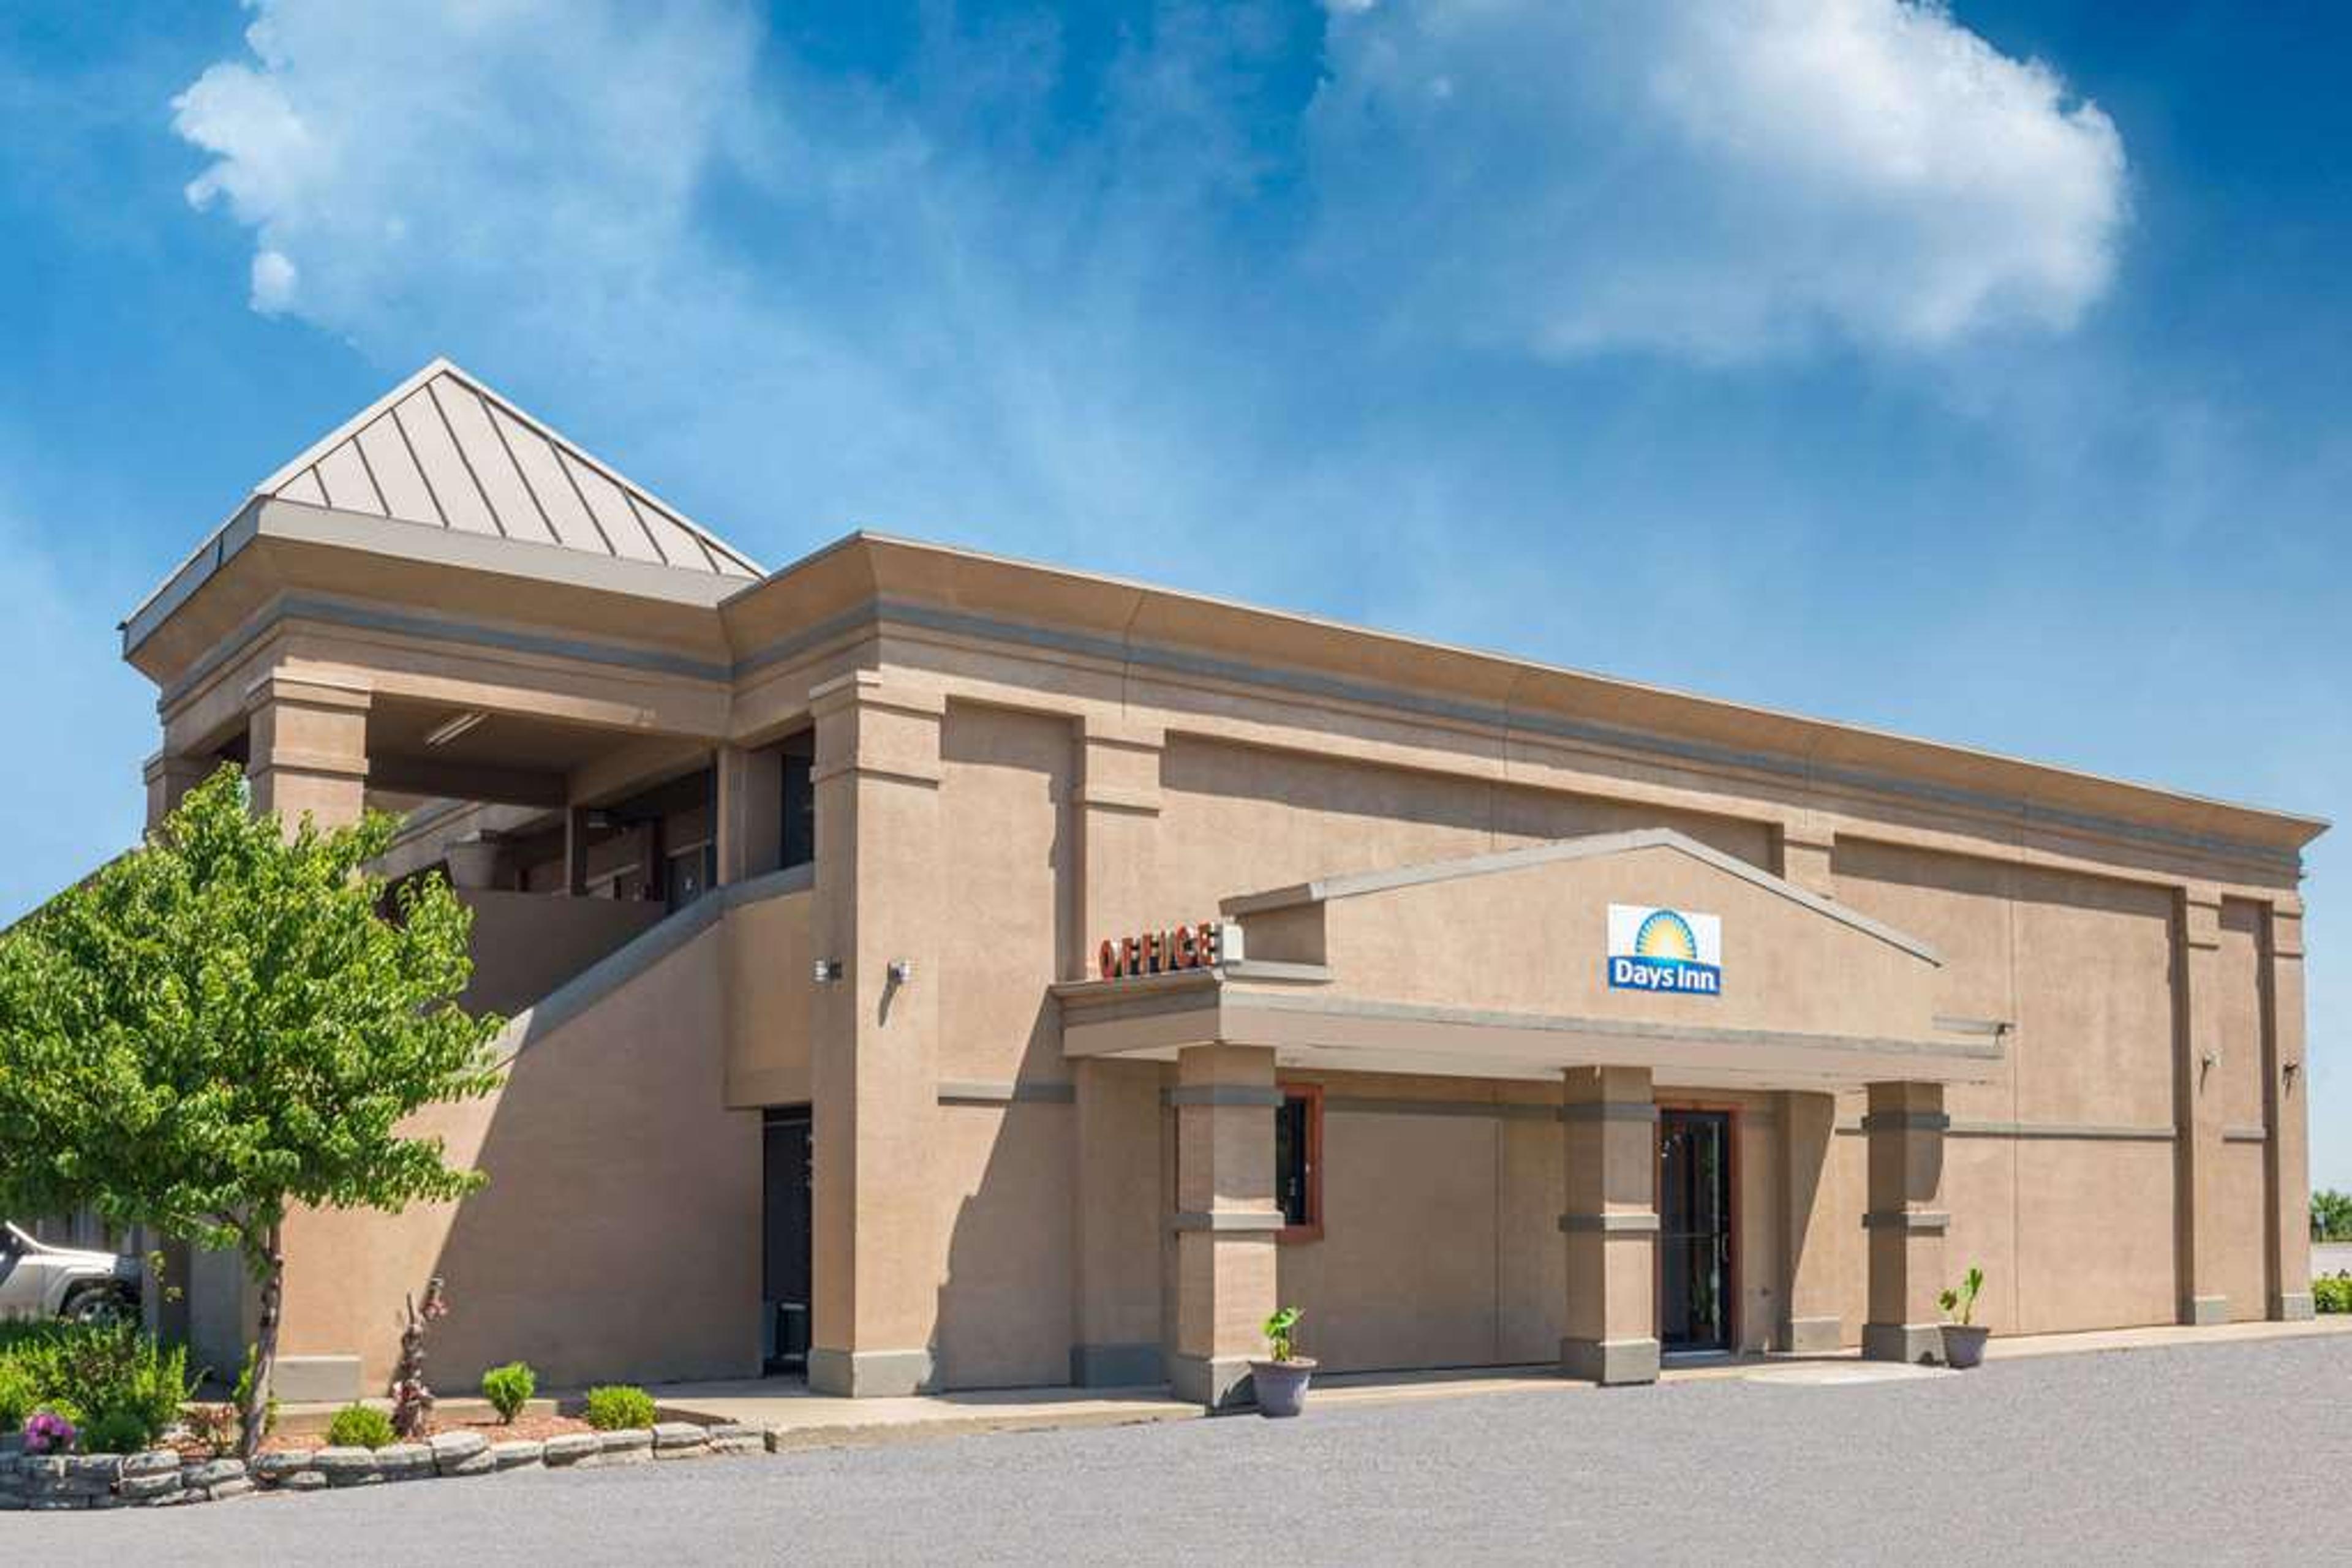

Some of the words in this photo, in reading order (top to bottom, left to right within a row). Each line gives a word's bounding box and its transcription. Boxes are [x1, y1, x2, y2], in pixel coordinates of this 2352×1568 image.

[1099, 923, 1216, 978] OFFICE
[1615, 959, 1675, 989] Days
[1678, 964, 1715, 990] Inn
